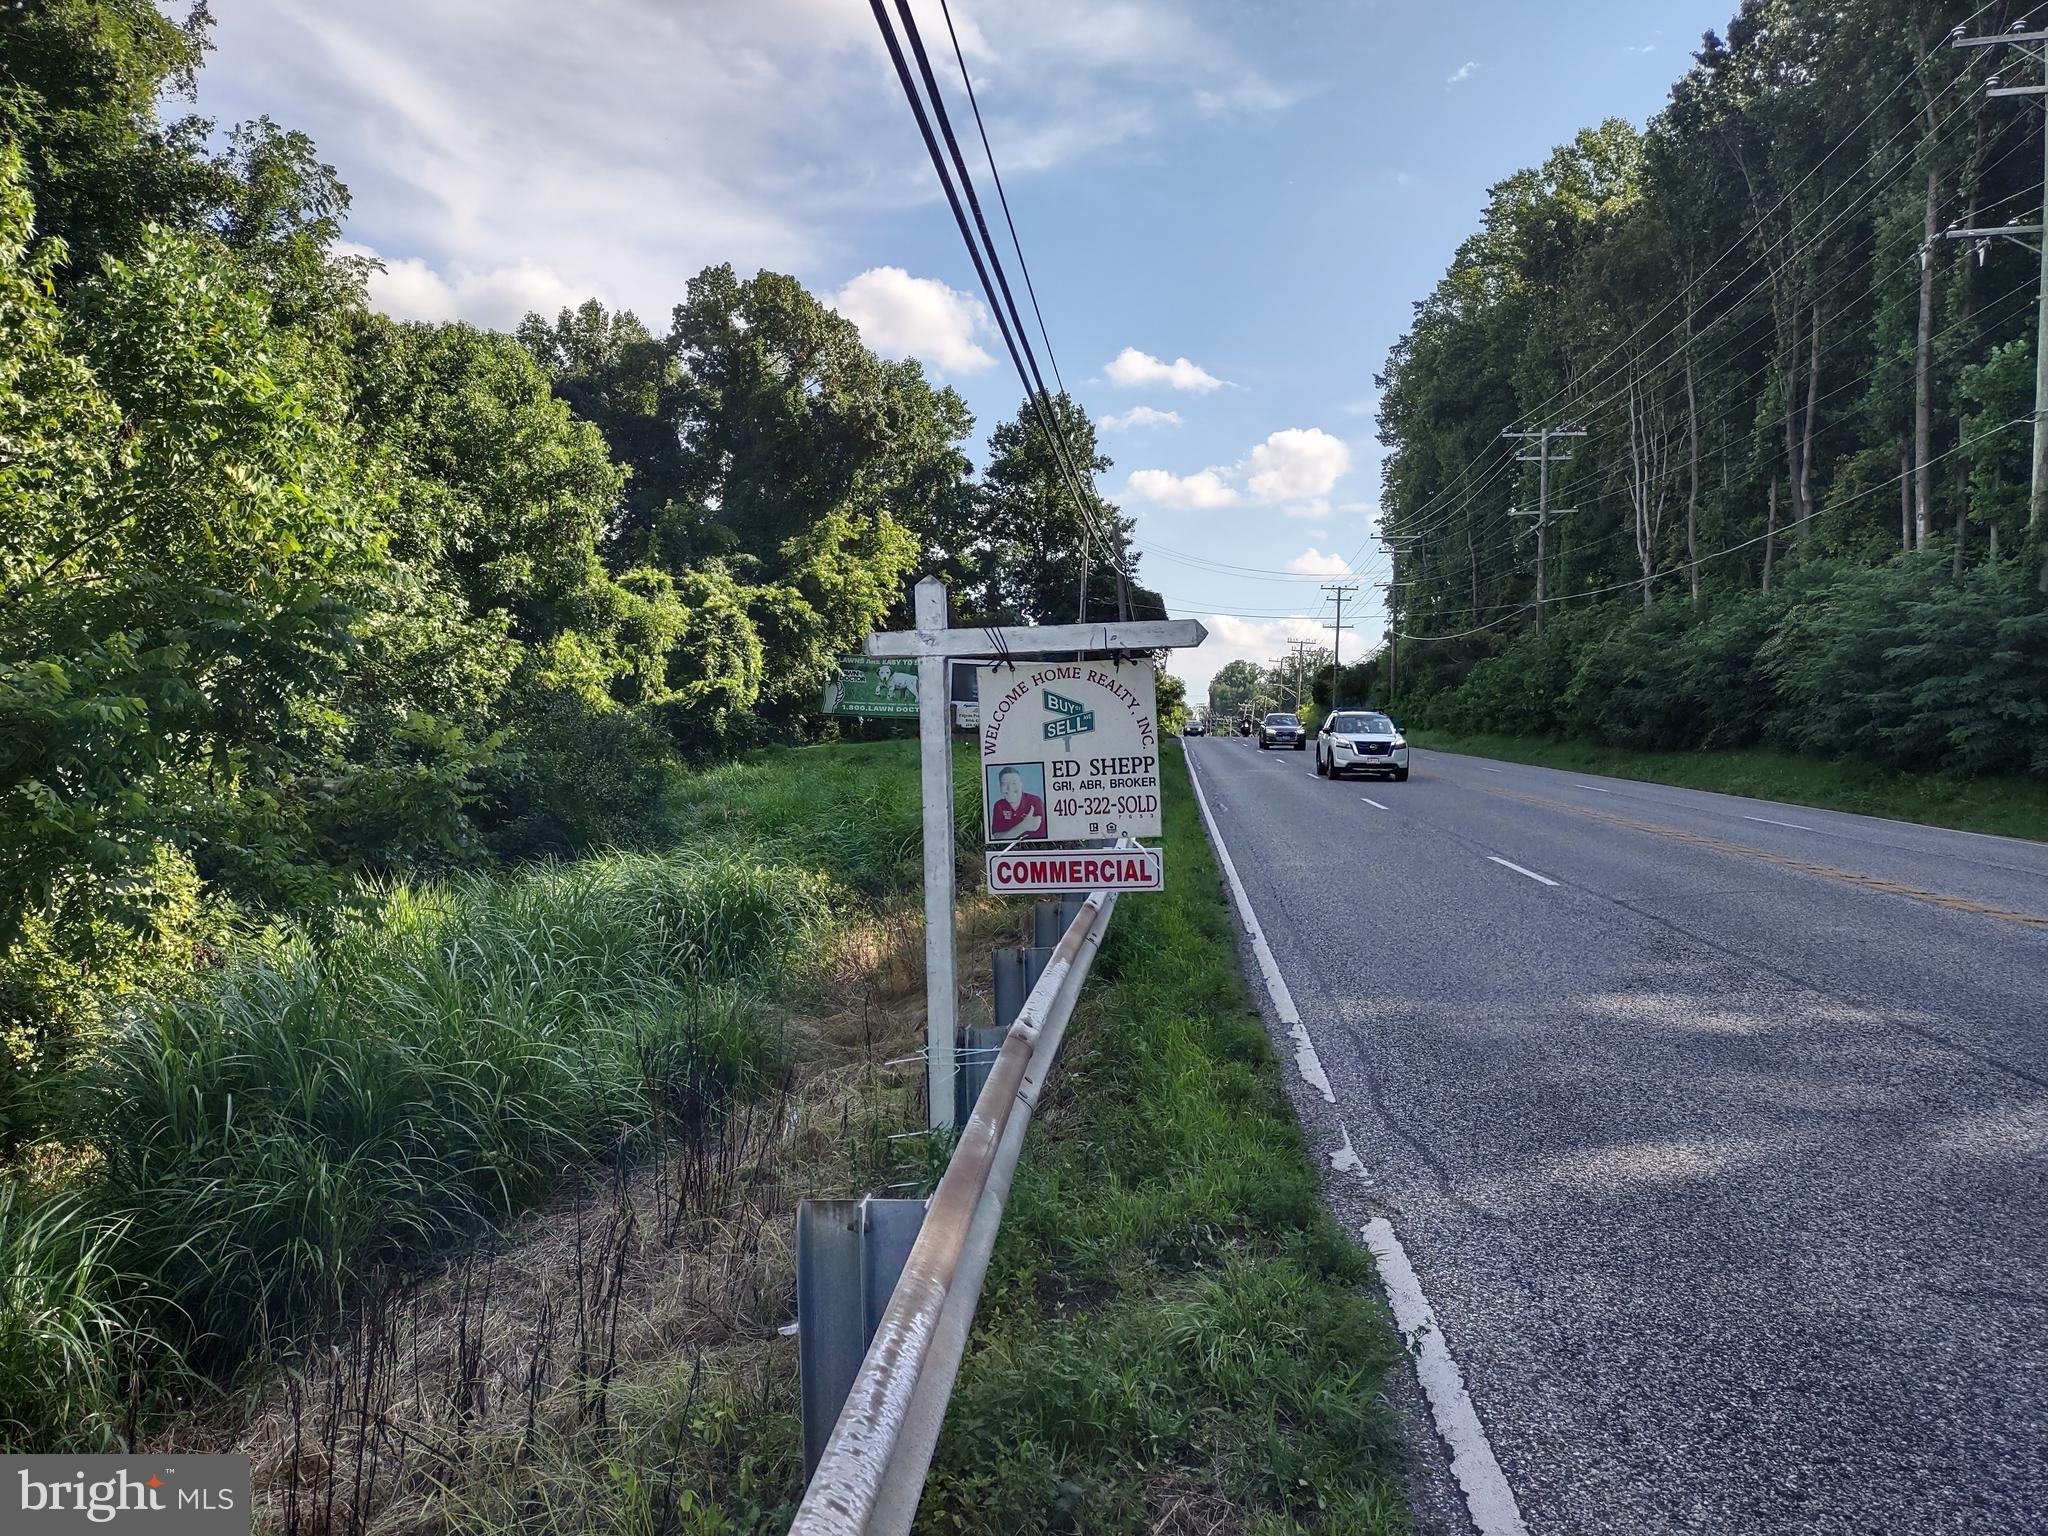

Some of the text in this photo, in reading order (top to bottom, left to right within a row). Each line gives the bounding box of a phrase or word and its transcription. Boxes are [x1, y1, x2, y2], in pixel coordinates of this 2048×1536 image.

[839, 675, 867, 683] DOCTOR
[984, 666, 1155, 757] WELCOME HOME REALTY, INC.
[1047, 694, 1075, 714] BUY
[1047, 716, 1088, 737] SELL
[1052, 756, 1155, 778] ED SHEPP
[1052, 777, 1157, 793] GRI, ABR, BROKER
[1053, 795, 1158, 817] 410-322-SOLD
[996, 858, 1153, 884] COMMERCIAL
